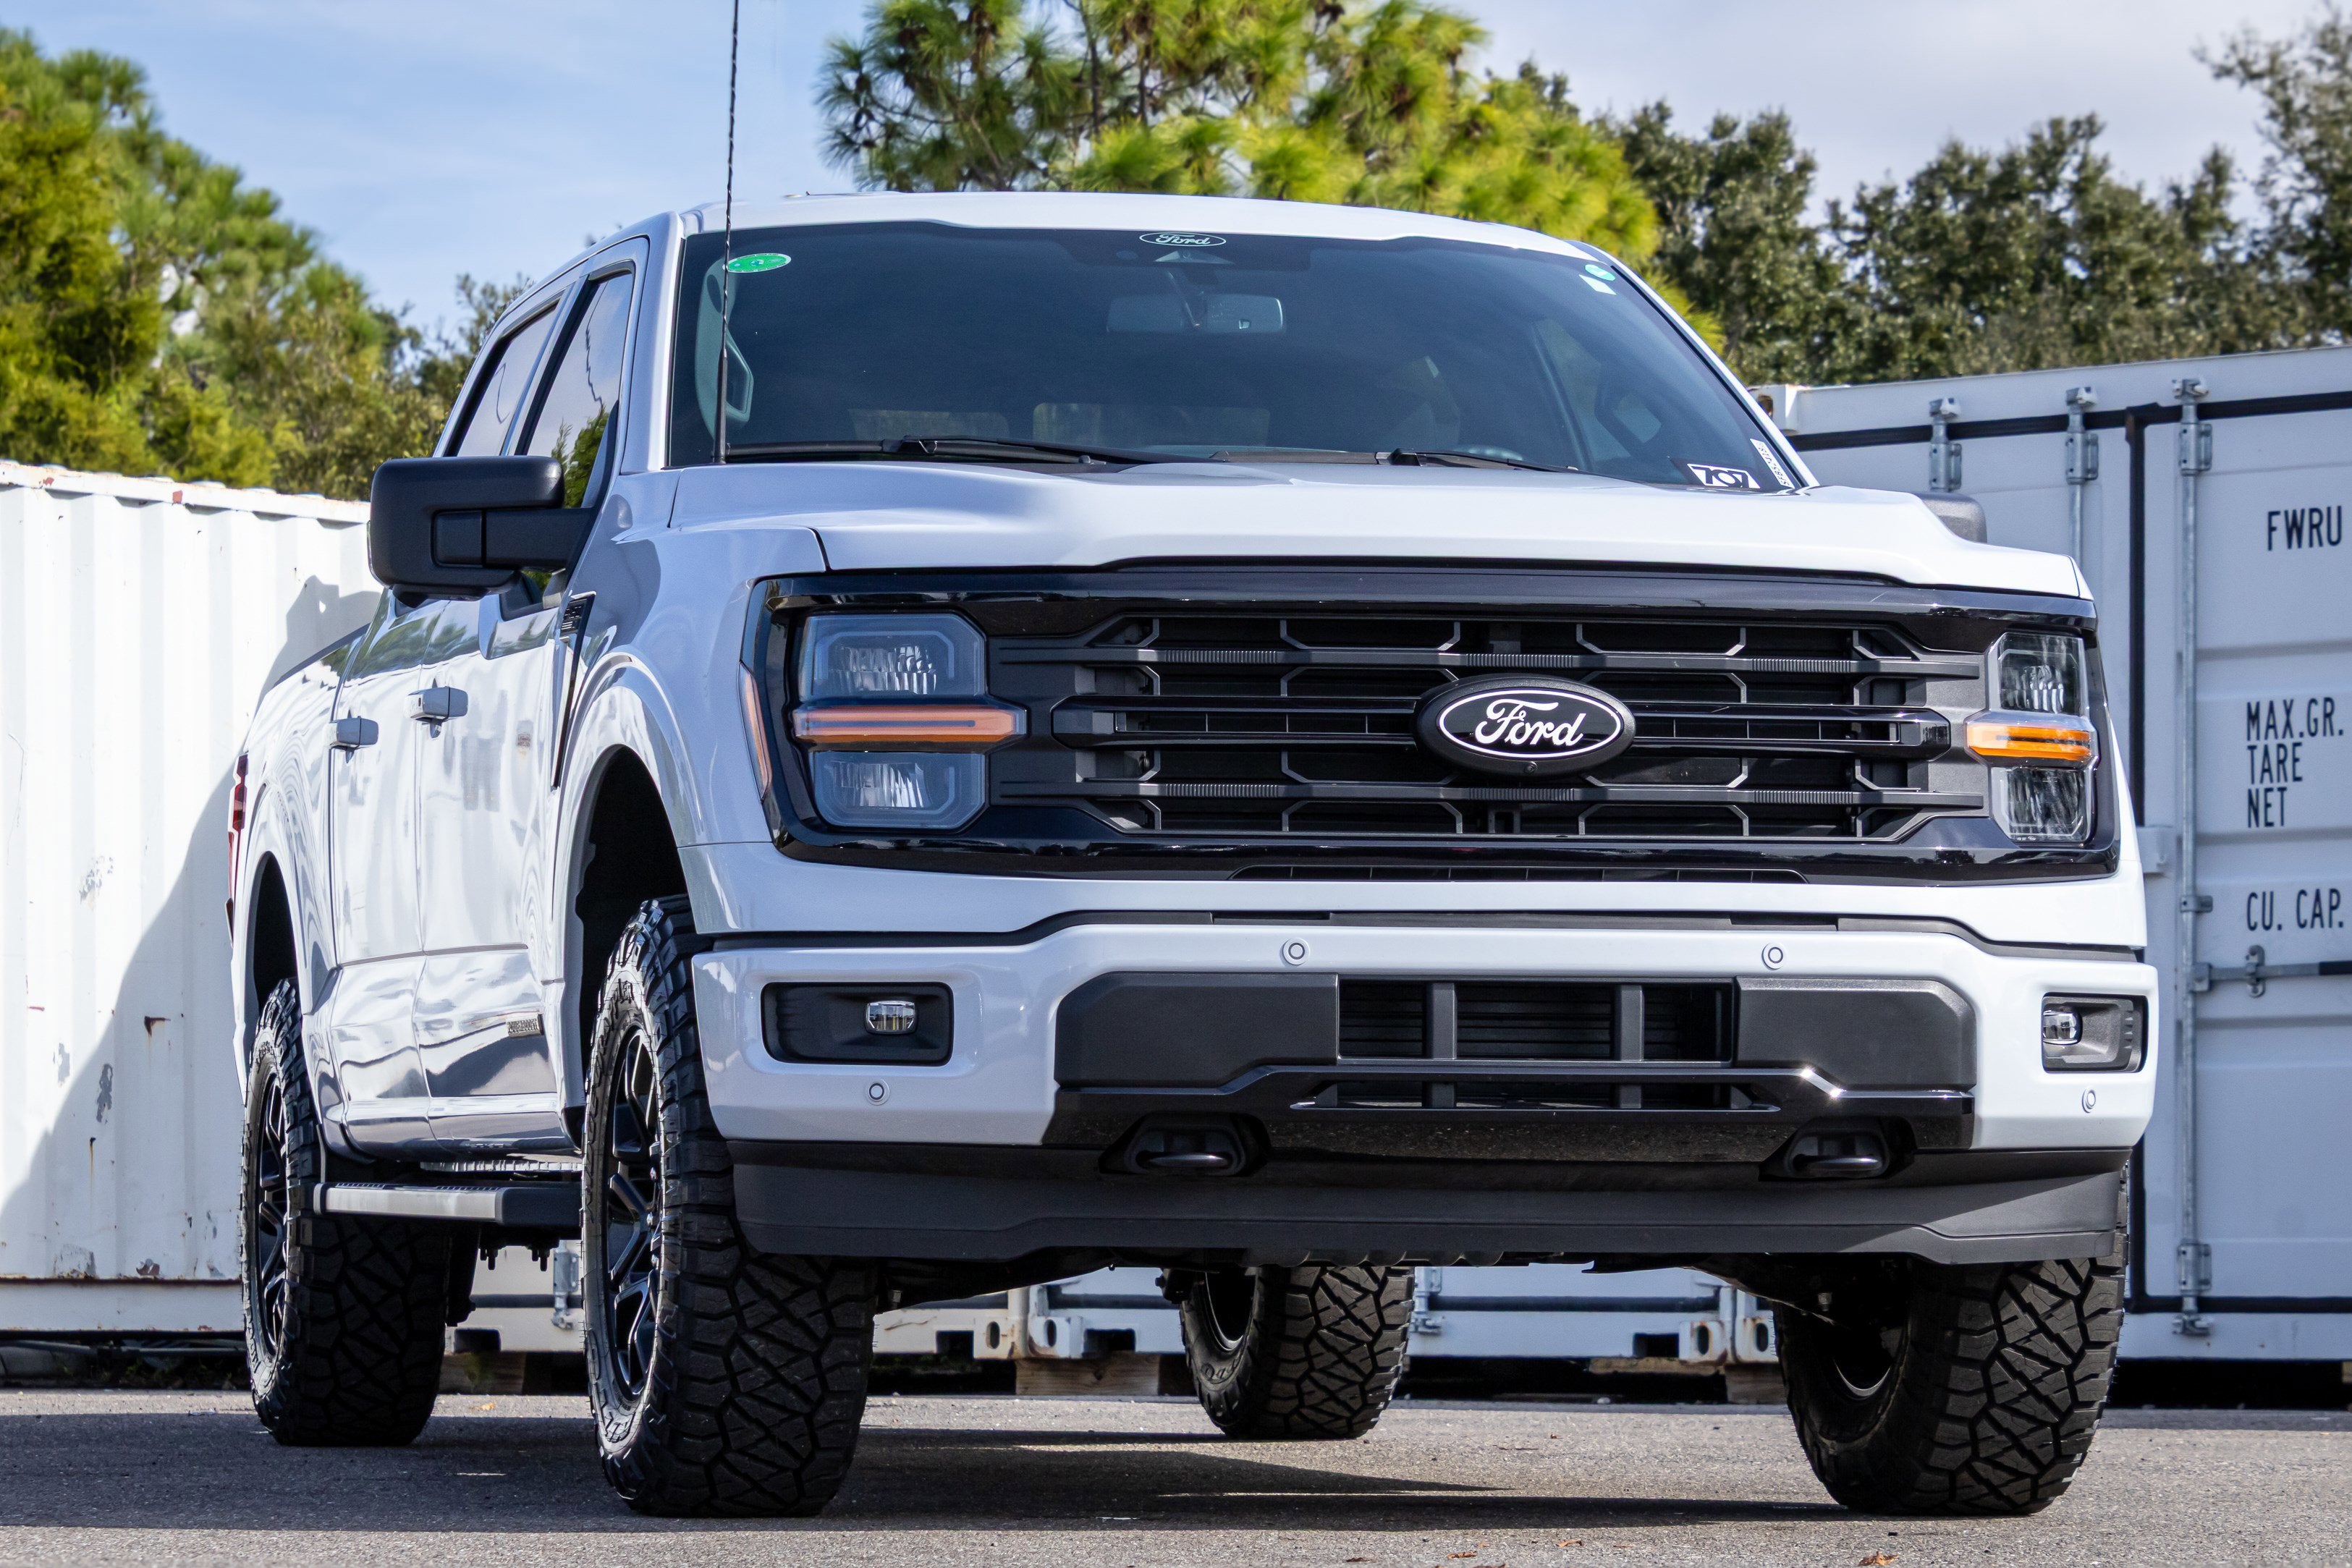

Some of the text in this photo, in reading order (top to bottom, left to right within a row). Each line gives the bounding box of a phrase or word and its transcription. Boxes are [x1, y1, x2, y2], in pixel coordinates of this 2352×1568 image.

[1155, 233, 1211, 245] Ford
[2267, 505, 2343, 551] FWRU
[1475, 698, 1587, 747] Ford
[2246, 697, 2344, 742] MAX.GR.
[2246, 742, 2303, 785] TARE
[2247, 786, 2288, 829] NET
[2246, 888, 2344, 932] CU. CAP.
